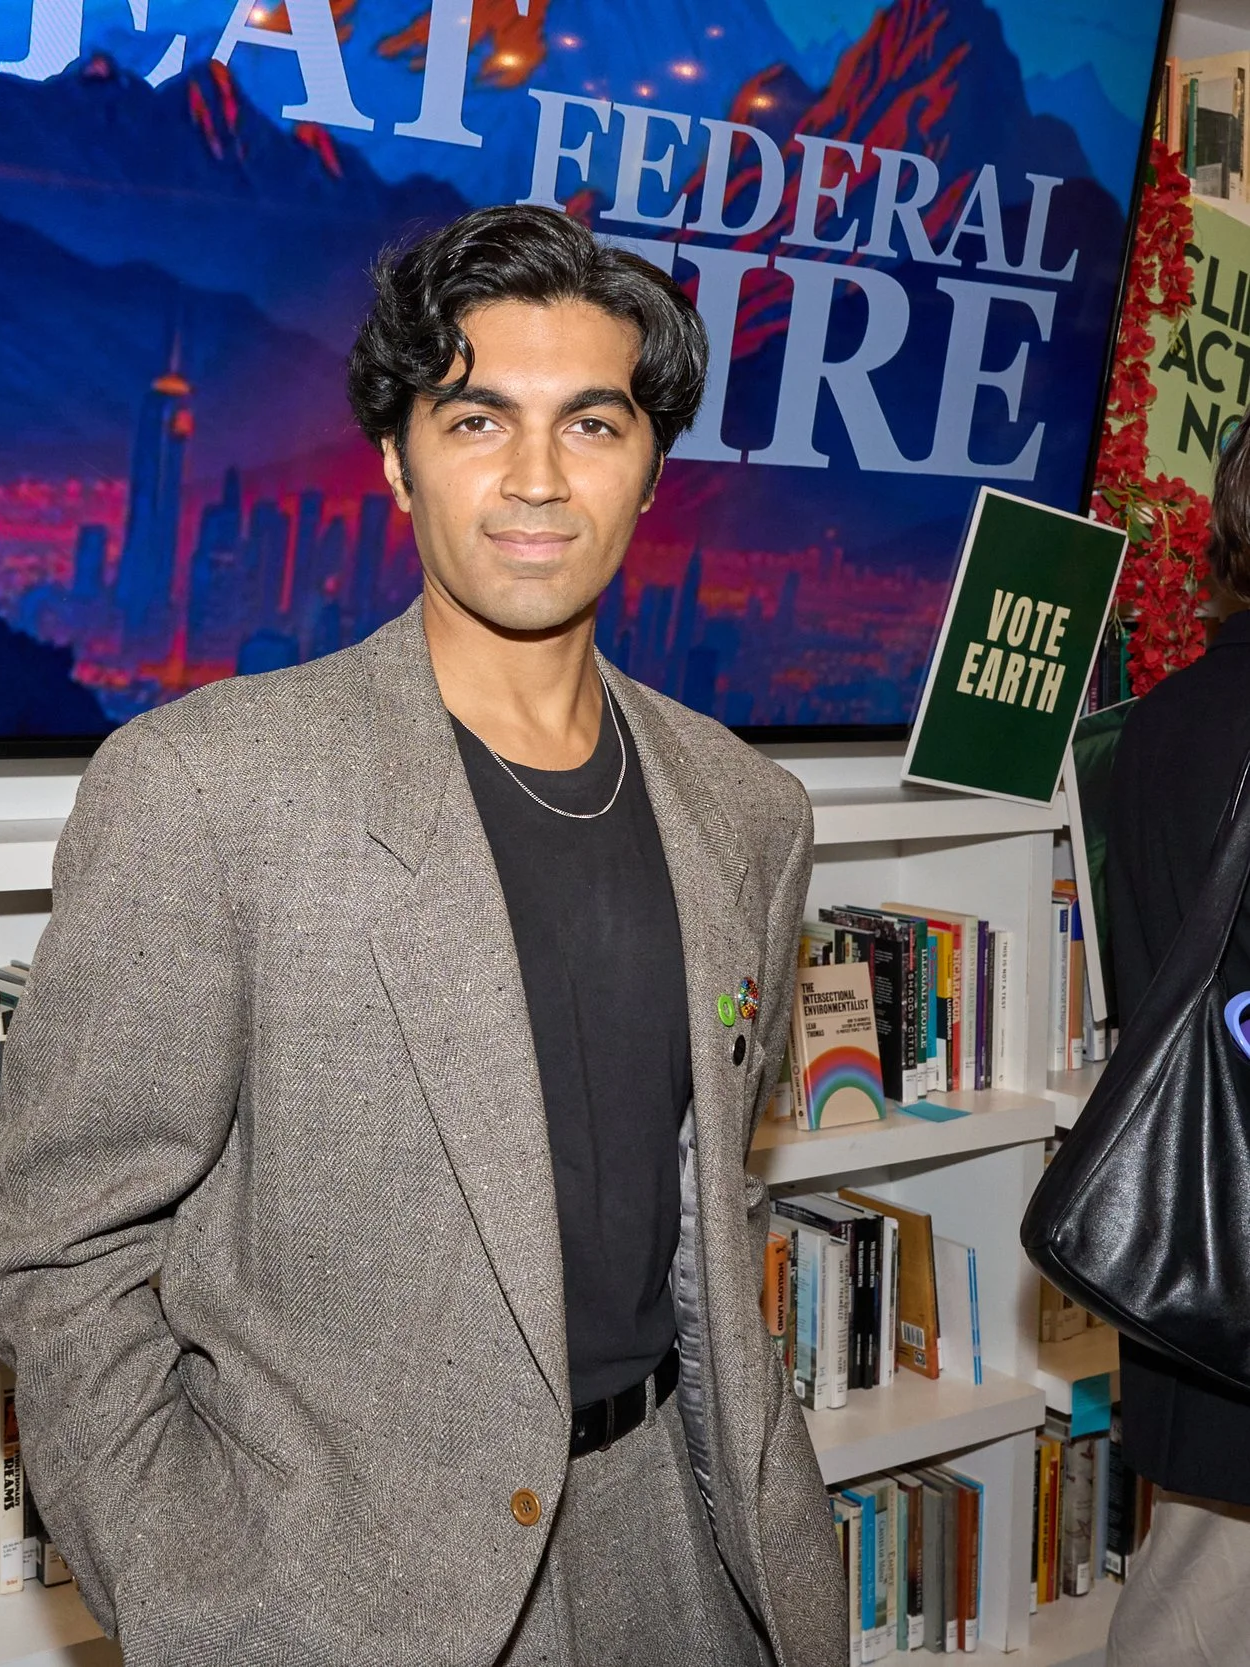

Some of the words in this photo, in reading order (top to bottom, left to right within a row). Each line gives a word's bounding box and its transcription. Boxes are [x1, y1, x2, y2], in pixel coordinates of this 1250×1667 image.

[515, 88, 1078, 282] FEDERAL
[595, 230, 1058, 482] IRE
[986, 588, 1071, 658] VOTE
[956, 641, 1066, 714] EARTH
[801, 982, 814, 993] THE
[802, 990, 856, 1005] INTERSECTIONAL
[804, 999, 869, 1016] ENVIRONMENTALIST
[907, 973, 915, 1020] SHADOW
[907, 1025, 915, 1067] CITIES
